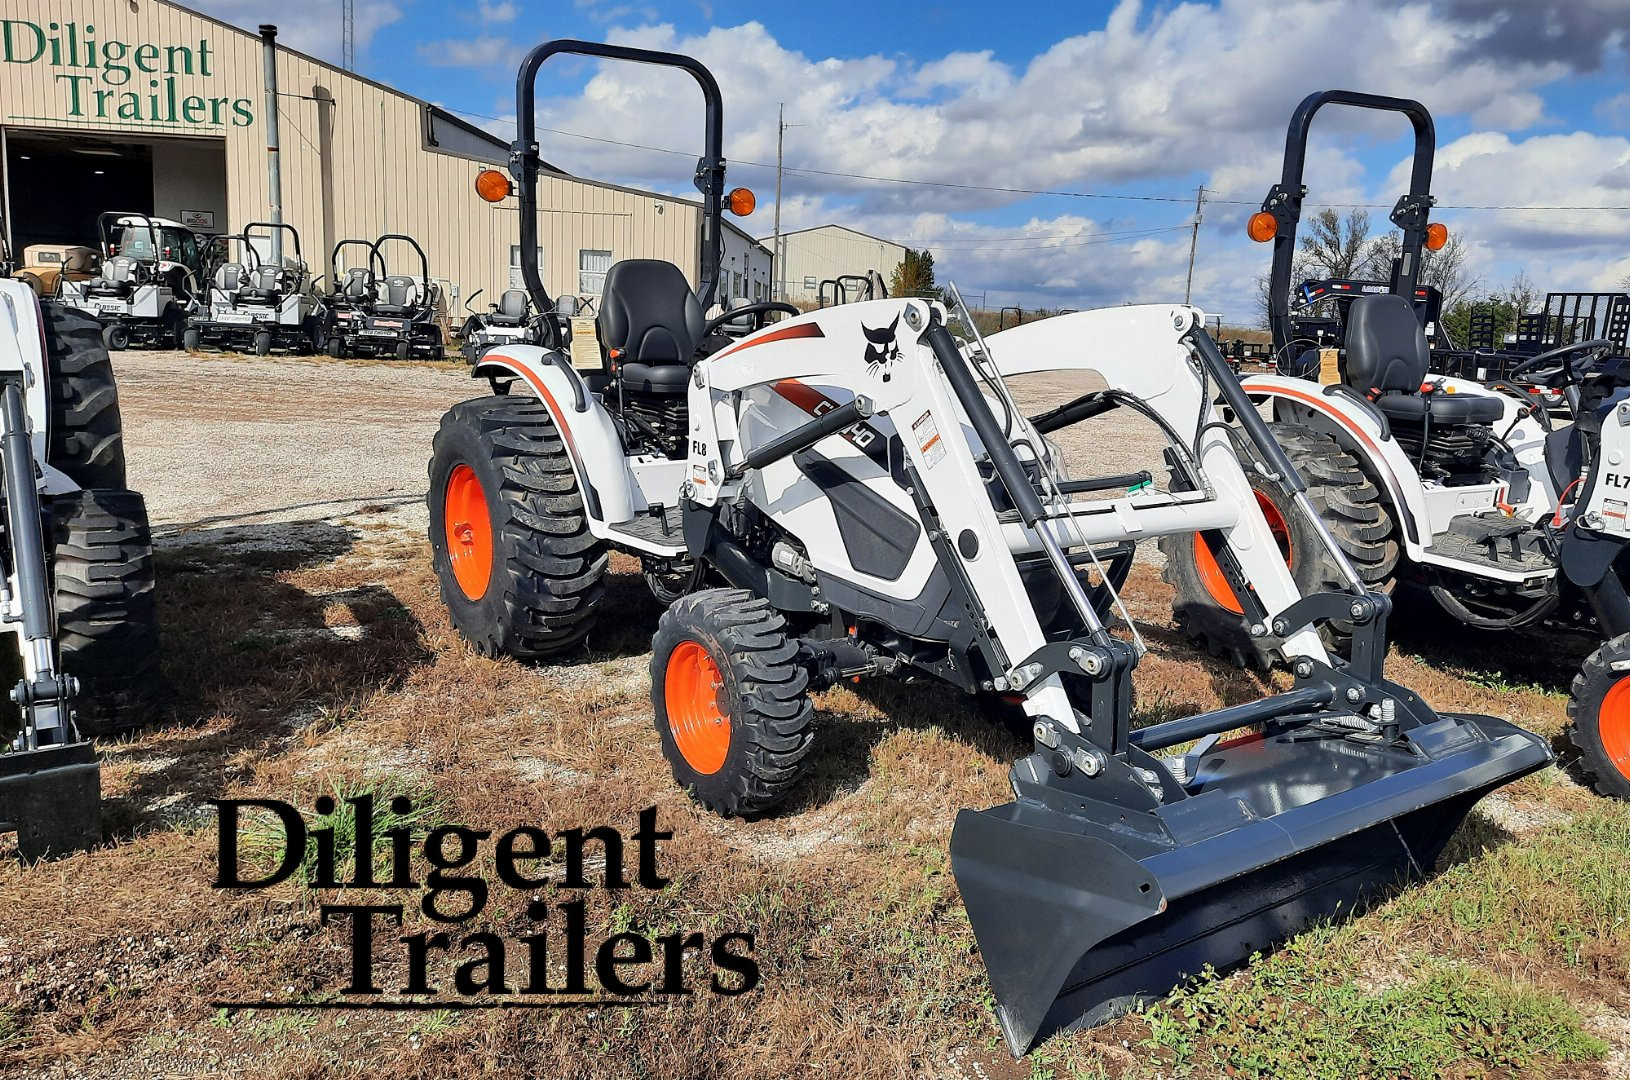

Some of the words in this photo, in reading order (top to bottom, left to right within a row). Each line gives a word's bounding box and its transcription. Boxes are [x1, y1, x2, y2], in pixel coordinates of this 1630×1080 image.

[1, 20, 213, 85] Diligent
[56, 75, 254, 127] Trailers
[693, 440, 706, 456] FL8
[1605, 473, 1630, 489] FL7
